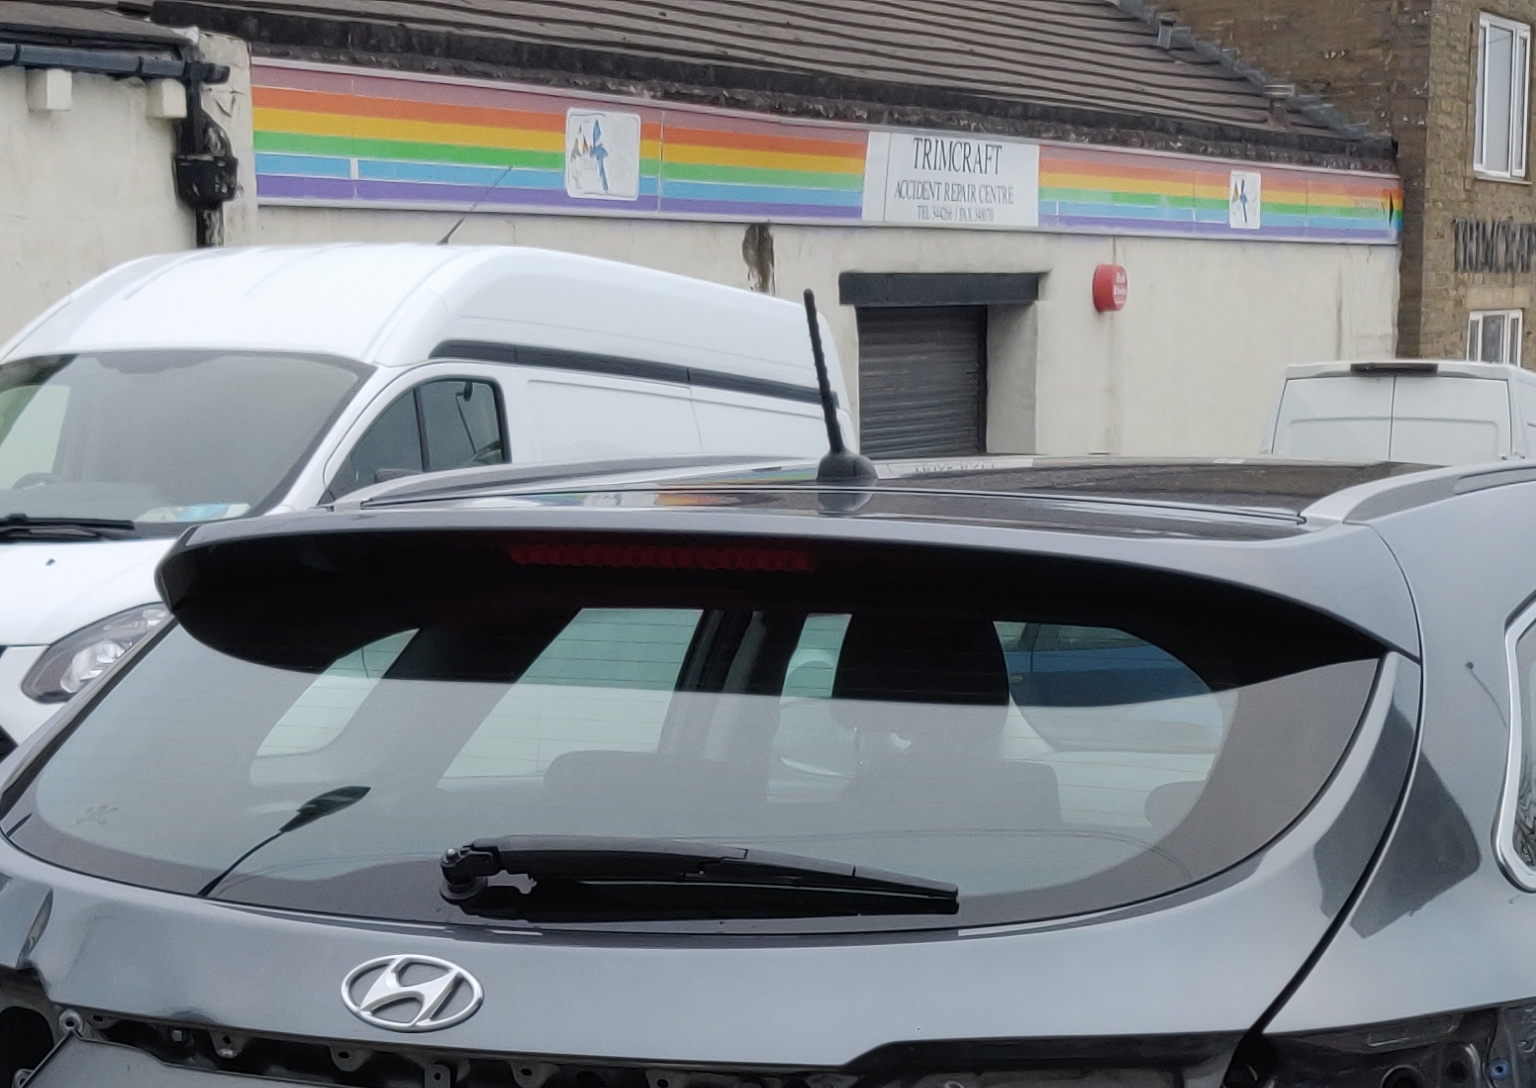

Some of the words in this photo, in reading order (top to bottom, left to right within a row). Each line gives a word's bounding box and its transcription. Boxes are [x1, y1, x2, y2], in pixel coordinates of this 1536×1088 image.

[913, 137, 1003, 175] TRIMCRAFT
[894, 180, 943, 201] ACCIDENT
[944, 182, 977, 203] REPAIR
[978, 184, 1014, 205] CENTRE
